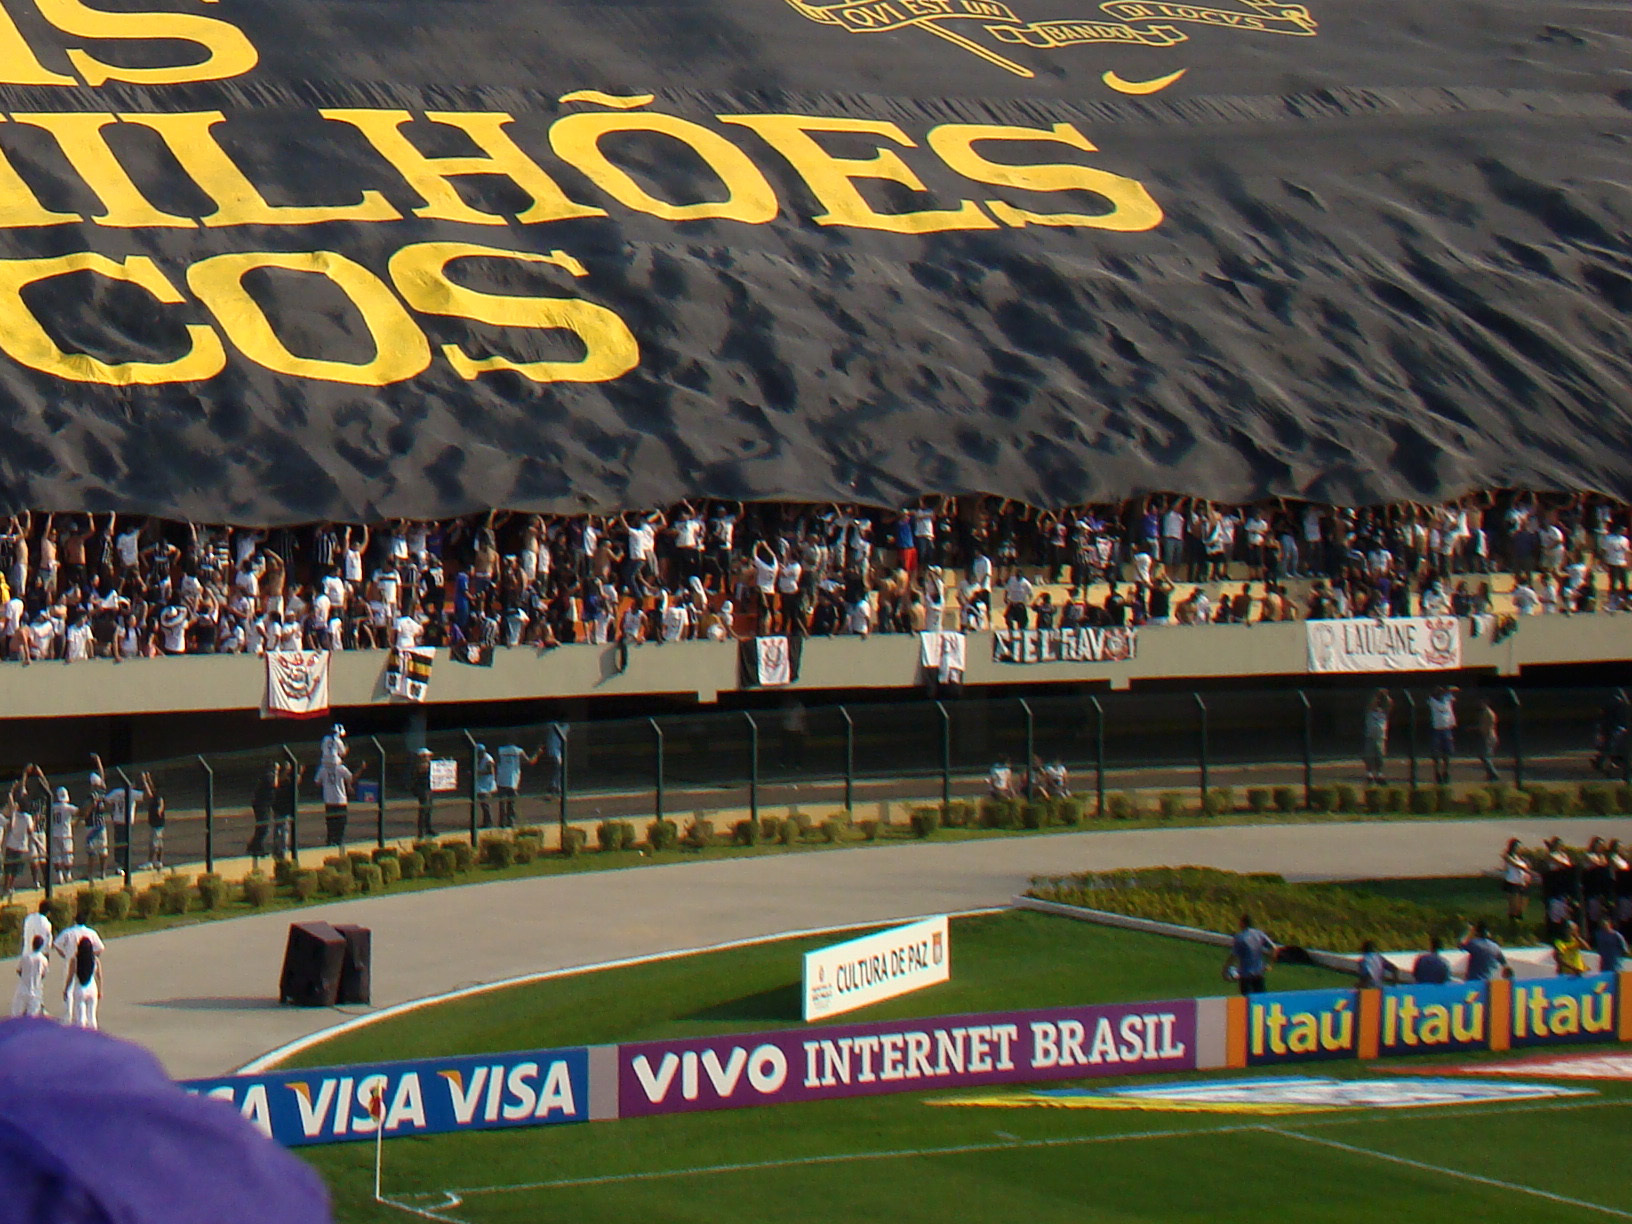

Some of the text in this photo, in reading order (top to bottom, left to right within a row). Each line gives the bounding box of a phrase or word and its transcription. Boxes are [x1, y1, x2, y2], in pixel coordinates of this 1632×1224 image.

[1044, 24, 1135, 41] BANDO
[1117, 4, 1155, 17] DI
[836, 940, 929, 994] CULTURA DE PAZ
[1250, 999, 1354, 1056] Itaú
[1382, 990, 1485, 1047] Itaú
[1513, 981, 1614, 1039] Itaú
[631, 1013, 1185, 1104] VIVO INTERNET BRASIL
[284, 1072, 426, 1138] VISA
[437, 1060, 577, 1124] VISA
